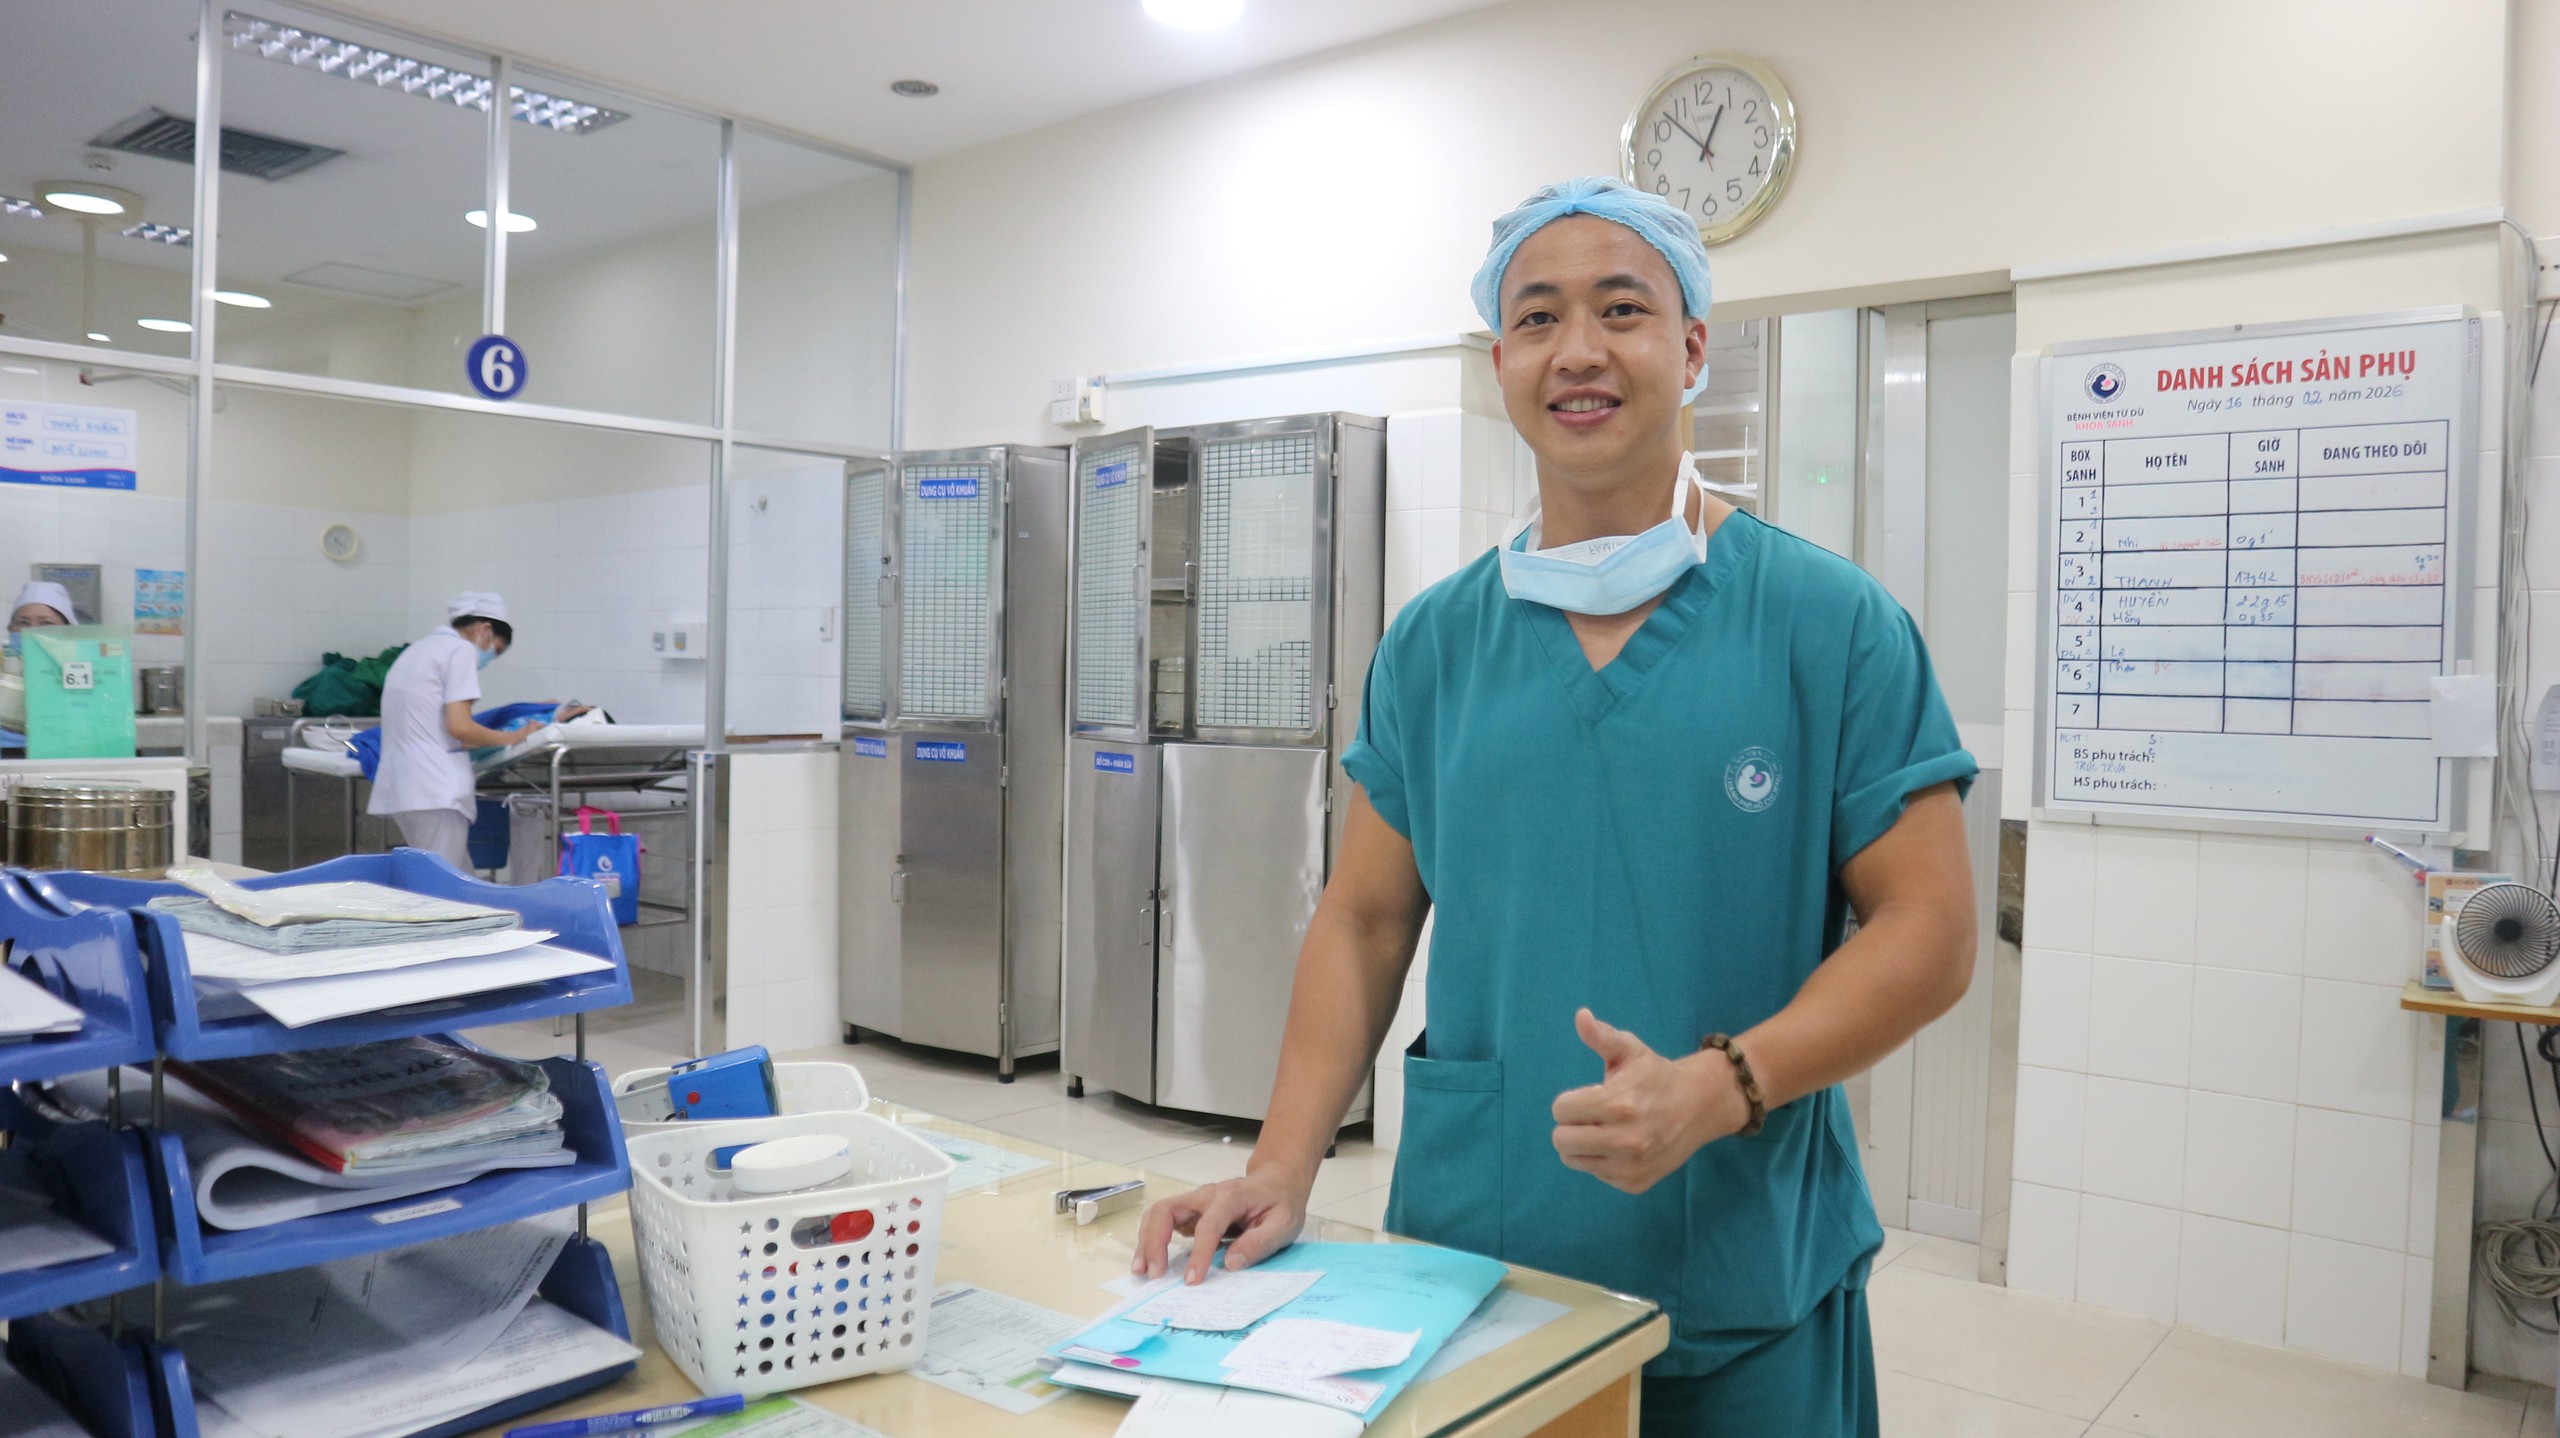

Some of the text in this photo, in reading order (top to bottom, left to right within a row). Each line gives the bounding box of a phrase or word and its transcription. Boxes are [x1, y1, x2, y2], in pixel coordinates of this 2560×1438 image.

[1694, 81, 1713, 106] 12
[1674, 97, 1687, 121] 11
[1743, 100, 1758, 124] 2
[1654, 119, 1671, 143] 10
[1753, 125, 1769, 149] 3
[1647, 148, 1662, 171] 9
[1748, 155, 1761, 177] 4
[1656, 174, 1670, 196] 8
[1726, 178, 1742, 202] 5
[1678, 188, 1690, 211] 7
[1702, 193, 1717, 216] 6
[481, 345, 515, 393] 6
[2157, 365, 2223, 392] DANH
[2231, 357, 2293, 387] SÁCH
[2300, 349, 2350, 383] SẢN
[2359, 350, 2416, 381] PHỤ
[2187, 384, 2404, 414] Ngày 16 tháng 02 năm 2026
[2067, 412, 2091, 422] BỆNH
[2093, 410, 2114, 421] VIỆN
[2075, 419, 2133, 431] KHOA SANH
[2258, 437, 2280, 452] GIỜ
[2323, 441, 2427, 461] ĐANG THEO DÕI
[2071, 449, 2091, 462] BOX
[2145, 453, 2187, 471] HỌ TÊN
[2254, 460, 2285, 473] SANH
[2066, 469, 2097, 482] SANH
[2076, 531, 2084, 543] 2
[2076, 566, 2084, 577] 3
[2115, 576, 2173, 588] THANH
[2074, 601, 2083, 613] 4
[2075, 635, 2083, 647] 5
[66, 673, 90, 685] 6.1
[2073, 670, 2082, 681] 6
[2072, 703, 2080, 715] 7
[2074, 748, 2155, 763] BS phụ trách:
[2074, 777, 2157, 791] HS phụ trách:
